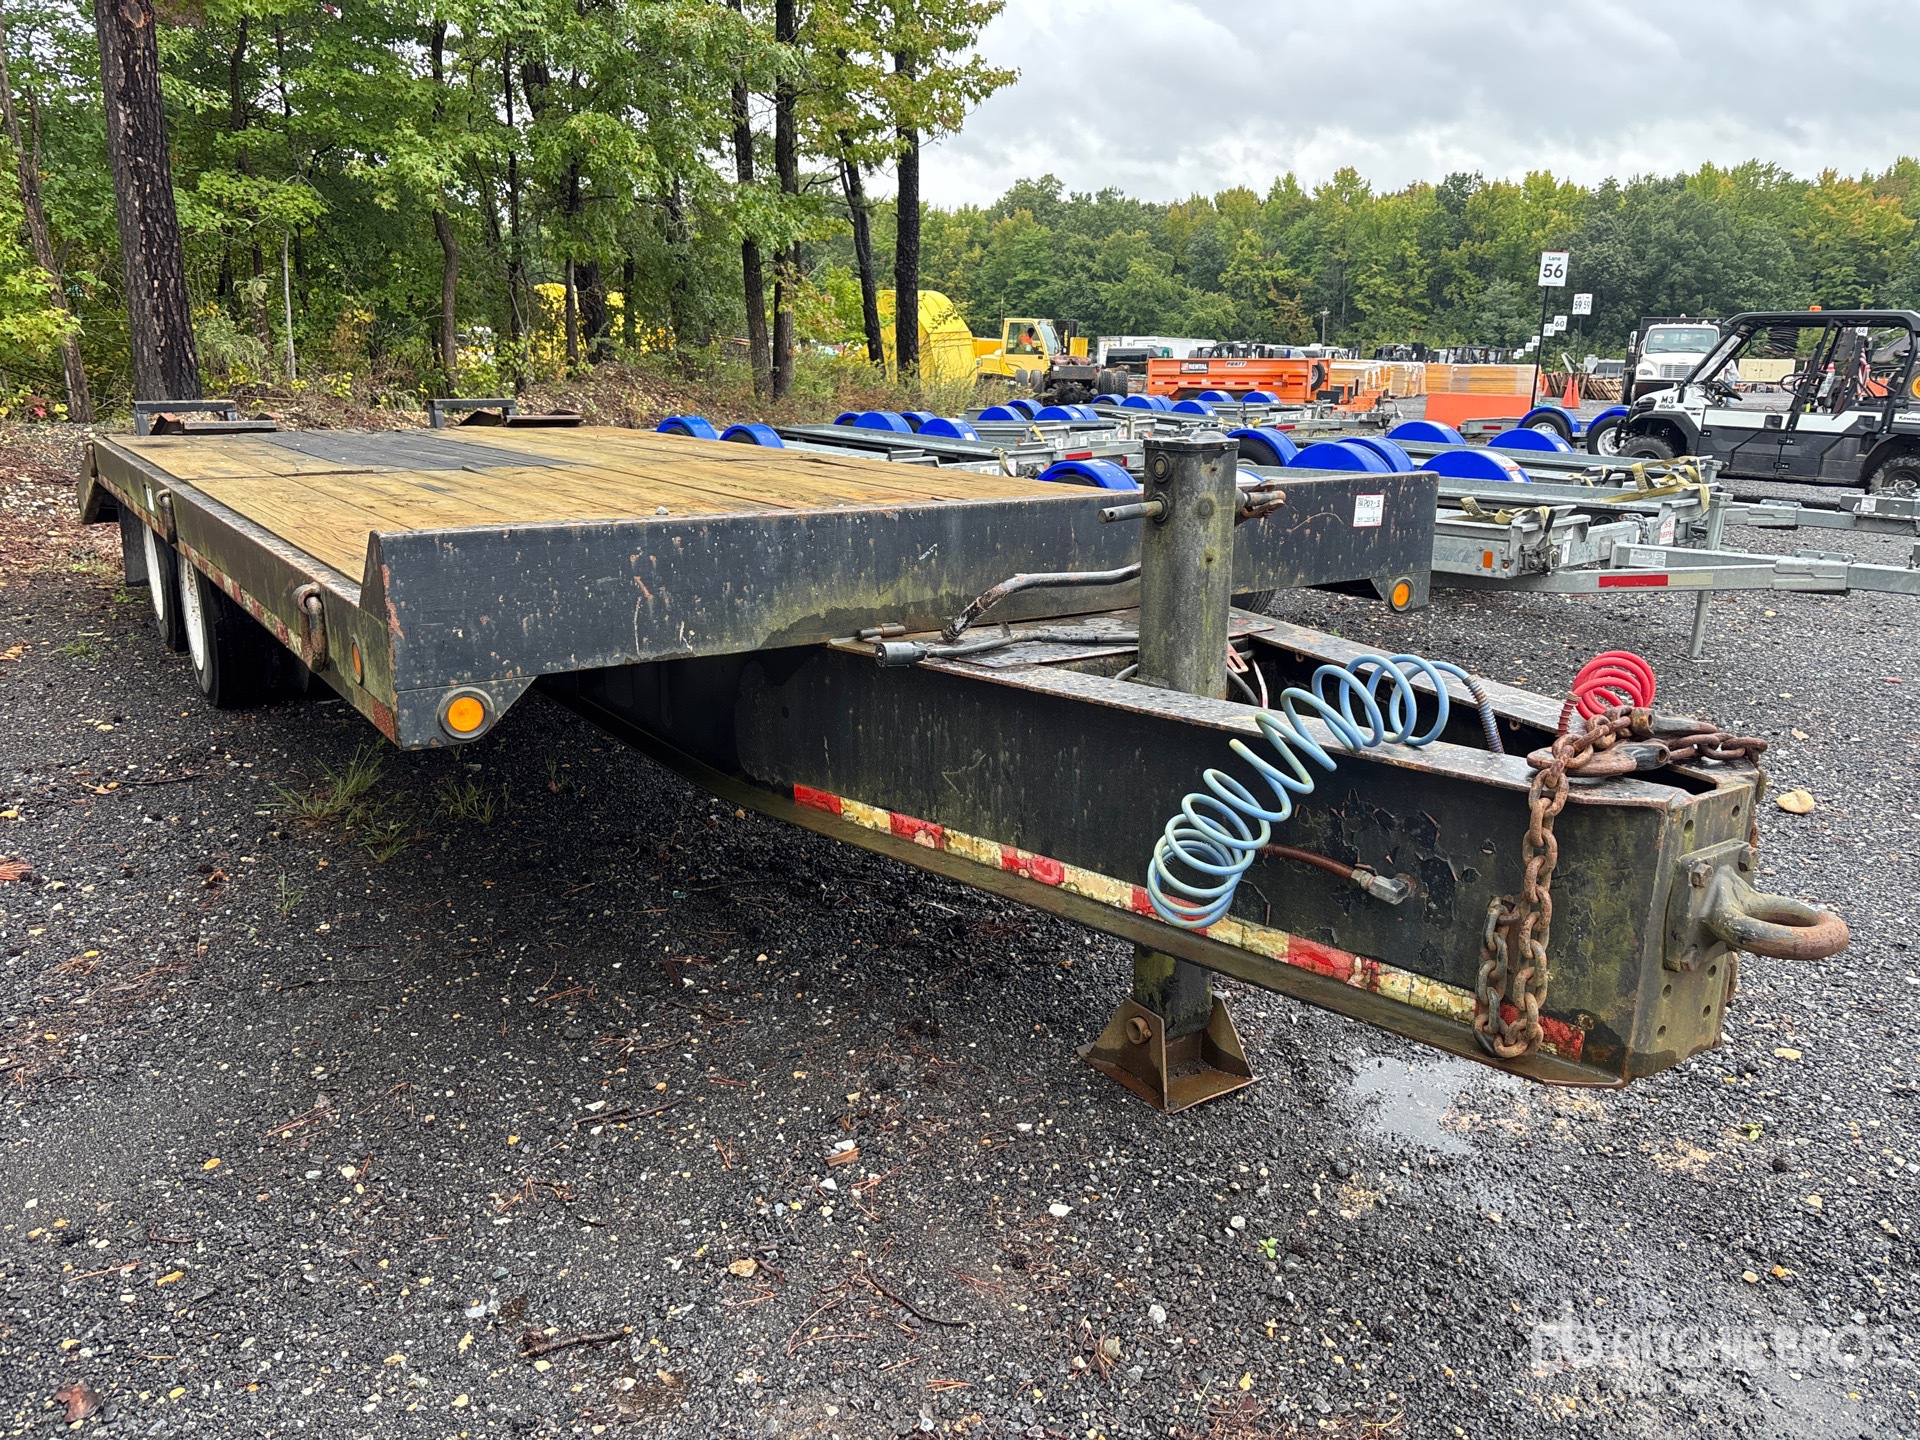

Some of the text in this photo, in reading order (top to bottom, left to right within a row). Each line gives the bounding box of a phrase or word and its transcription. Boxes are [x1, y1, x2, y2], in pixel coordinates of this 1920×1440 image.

[1542, 263, 1564, 279] 56
[1574, 300, 1583, 310] 59
[1660, 395, 1675, 404] M3
